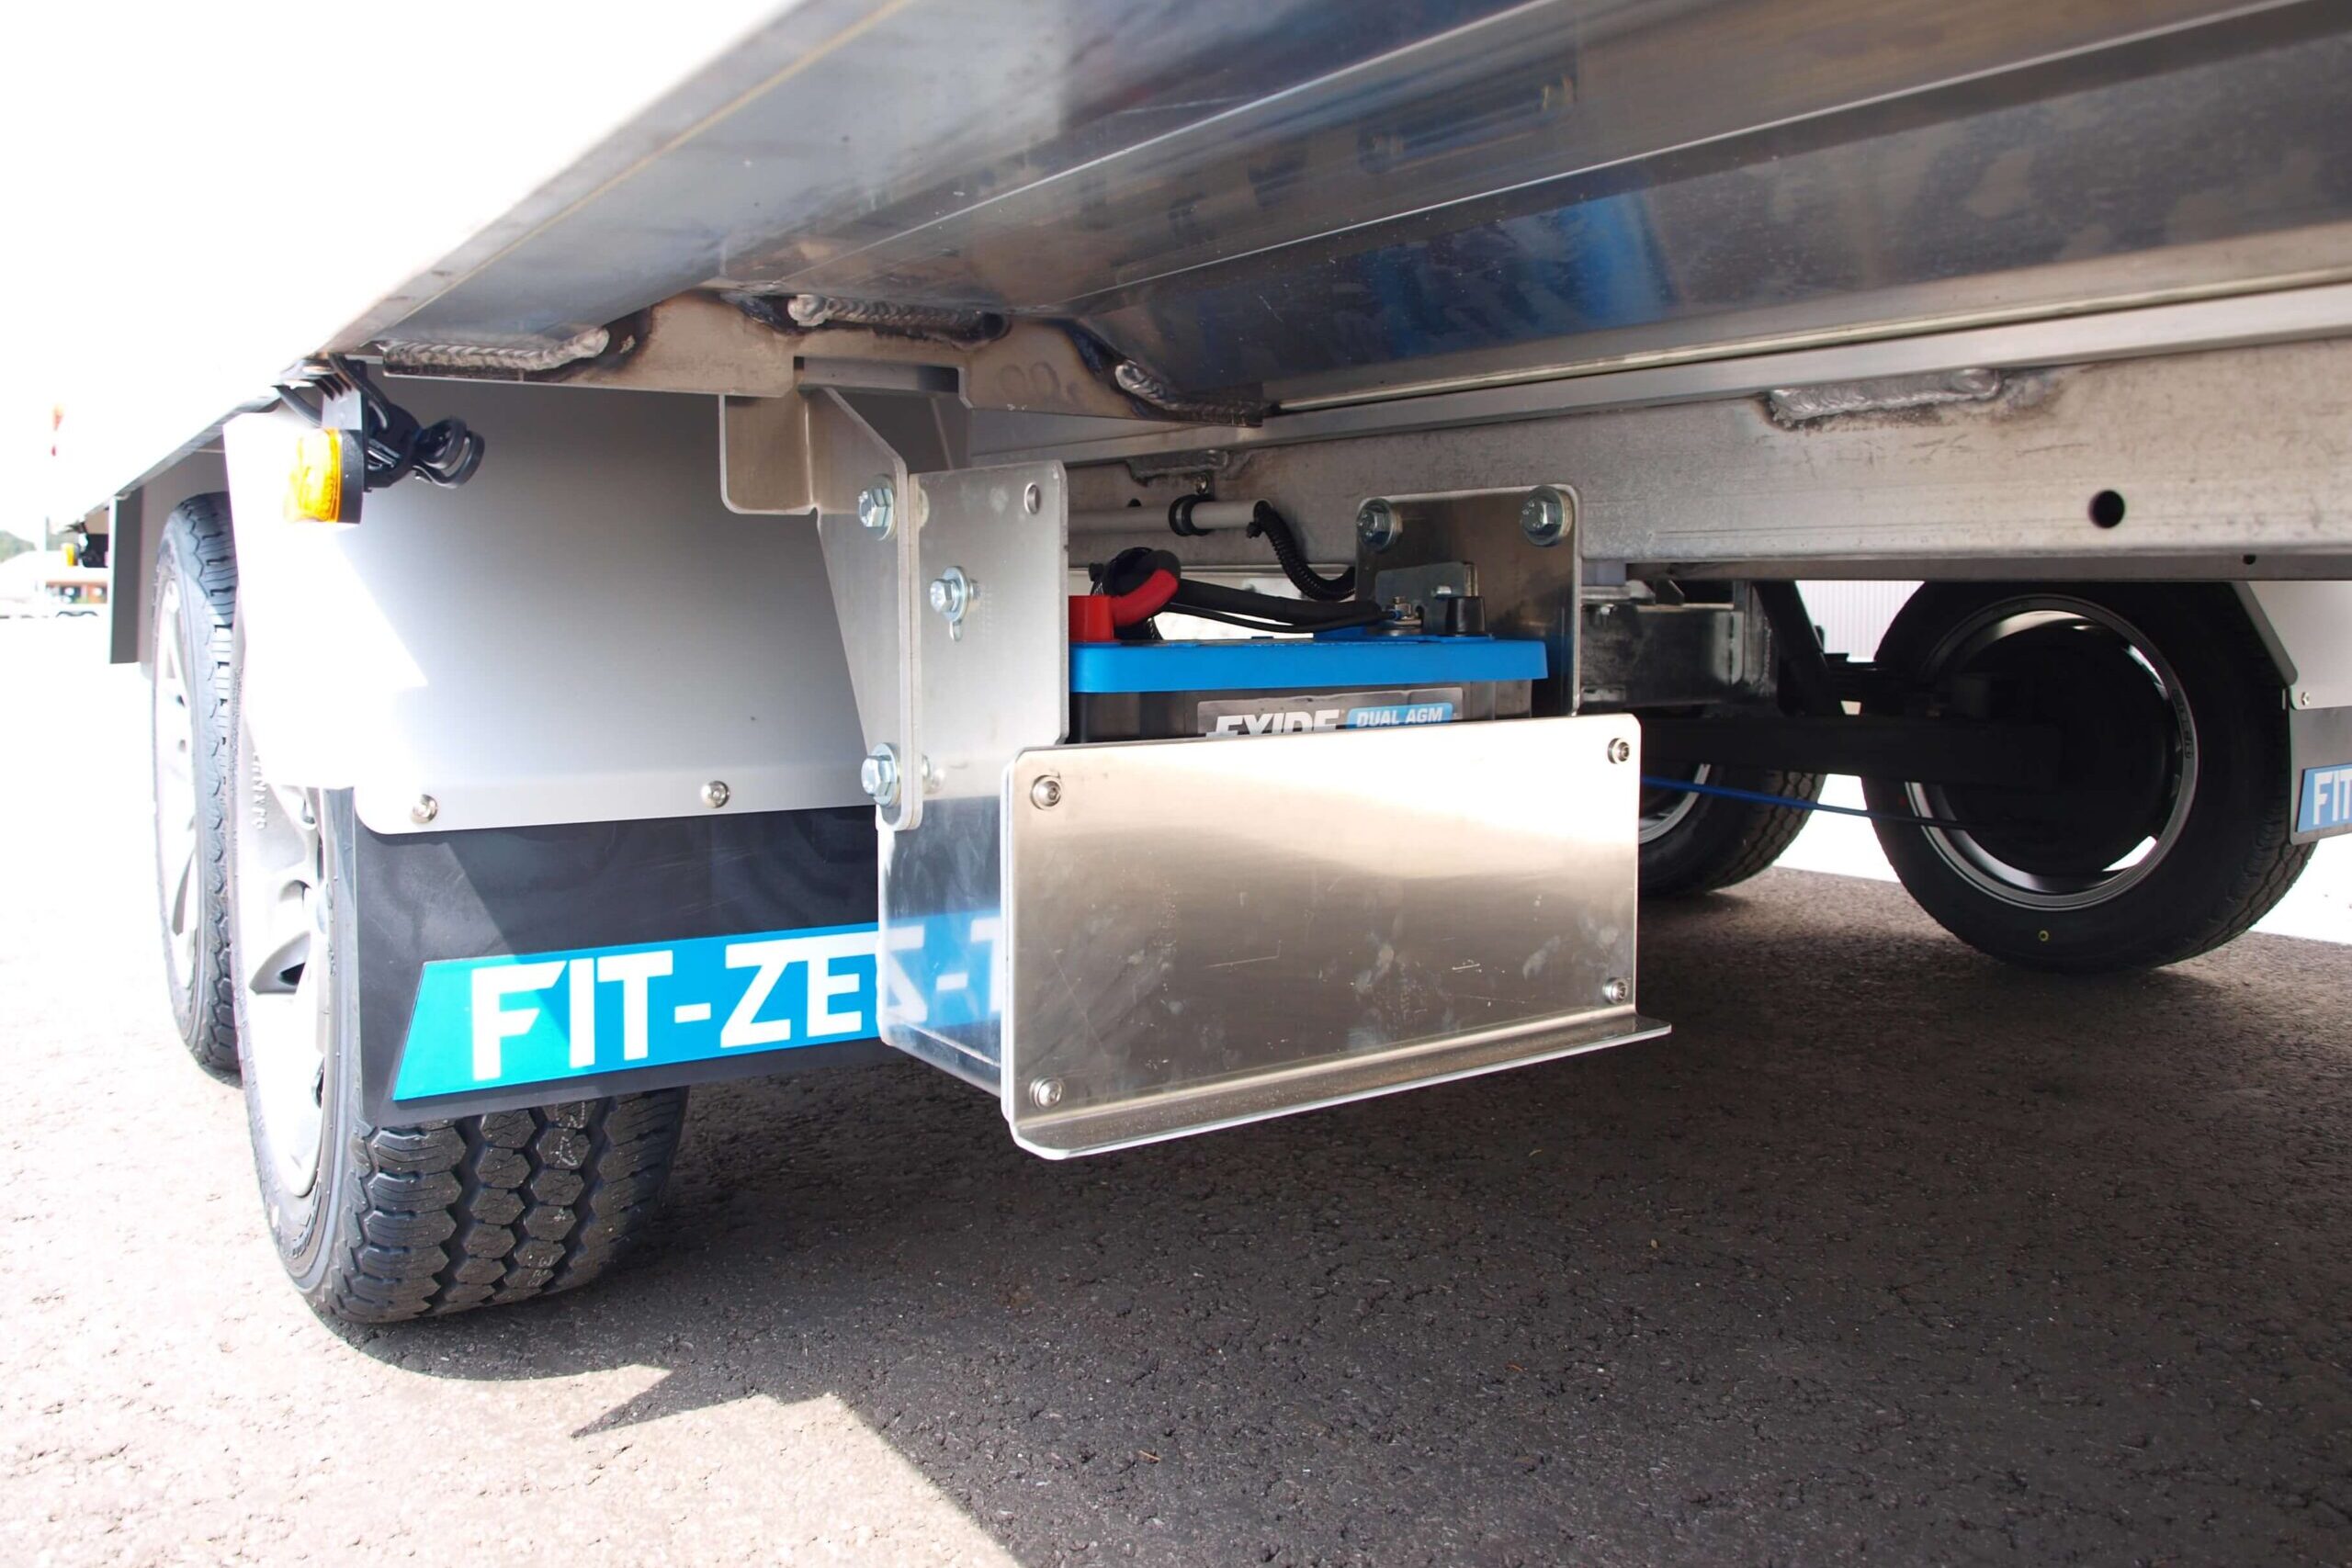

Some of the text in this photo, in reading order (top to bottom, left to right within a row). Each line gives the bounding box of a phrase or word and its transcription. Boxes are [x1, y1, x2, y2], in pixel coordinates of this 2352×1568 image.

[1356, 706, 1443, 728] DUAL AGM
[471, 930, 880, 1081] FIT-ZE
